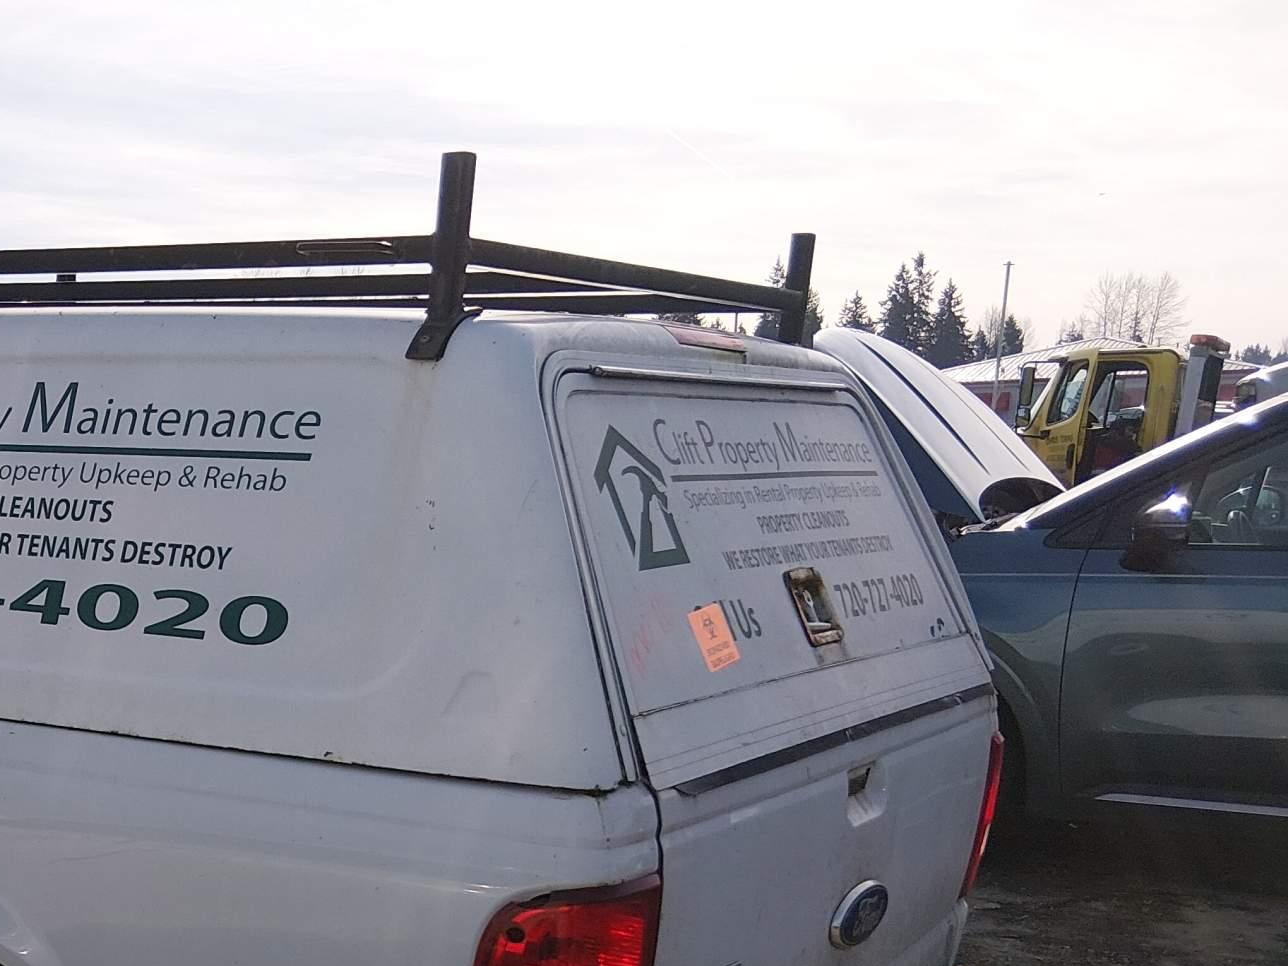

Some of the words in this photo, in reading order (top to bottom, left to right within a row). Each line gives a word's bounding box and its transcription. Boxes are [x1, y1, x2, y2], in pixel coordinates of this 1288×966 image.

[22, 381, 322, 440] Maintenance
[653, 418, 704, 465] Clift
[696, 420, 780, 471] Property
[773, 421, 872, 463] Maintenance
[79, 461, 171, 492] Upkeep
[178, 465, 197, 488] &
[203, 466, 288, 492] Rehab
[683, 486, 747, 512] Specializing
[753, 483, 785, 504] Rental
[756, 512, 804, 535] PROPERTY
[802, 510, 850, 531] CLEANOUTS
[17, 533, 116, 563] TENANTS
[120, 540, 232, 570] DESTROY
[722, 550, 743, 571] WE
[739, 546, 783, 568] RESTORE
[778, 542, 808, 564] WHAT
[804, 540, 832, 561] YOUR
[833, 573, 924, 619] 720-727-4020
[730, 599, 762, 639] Us
